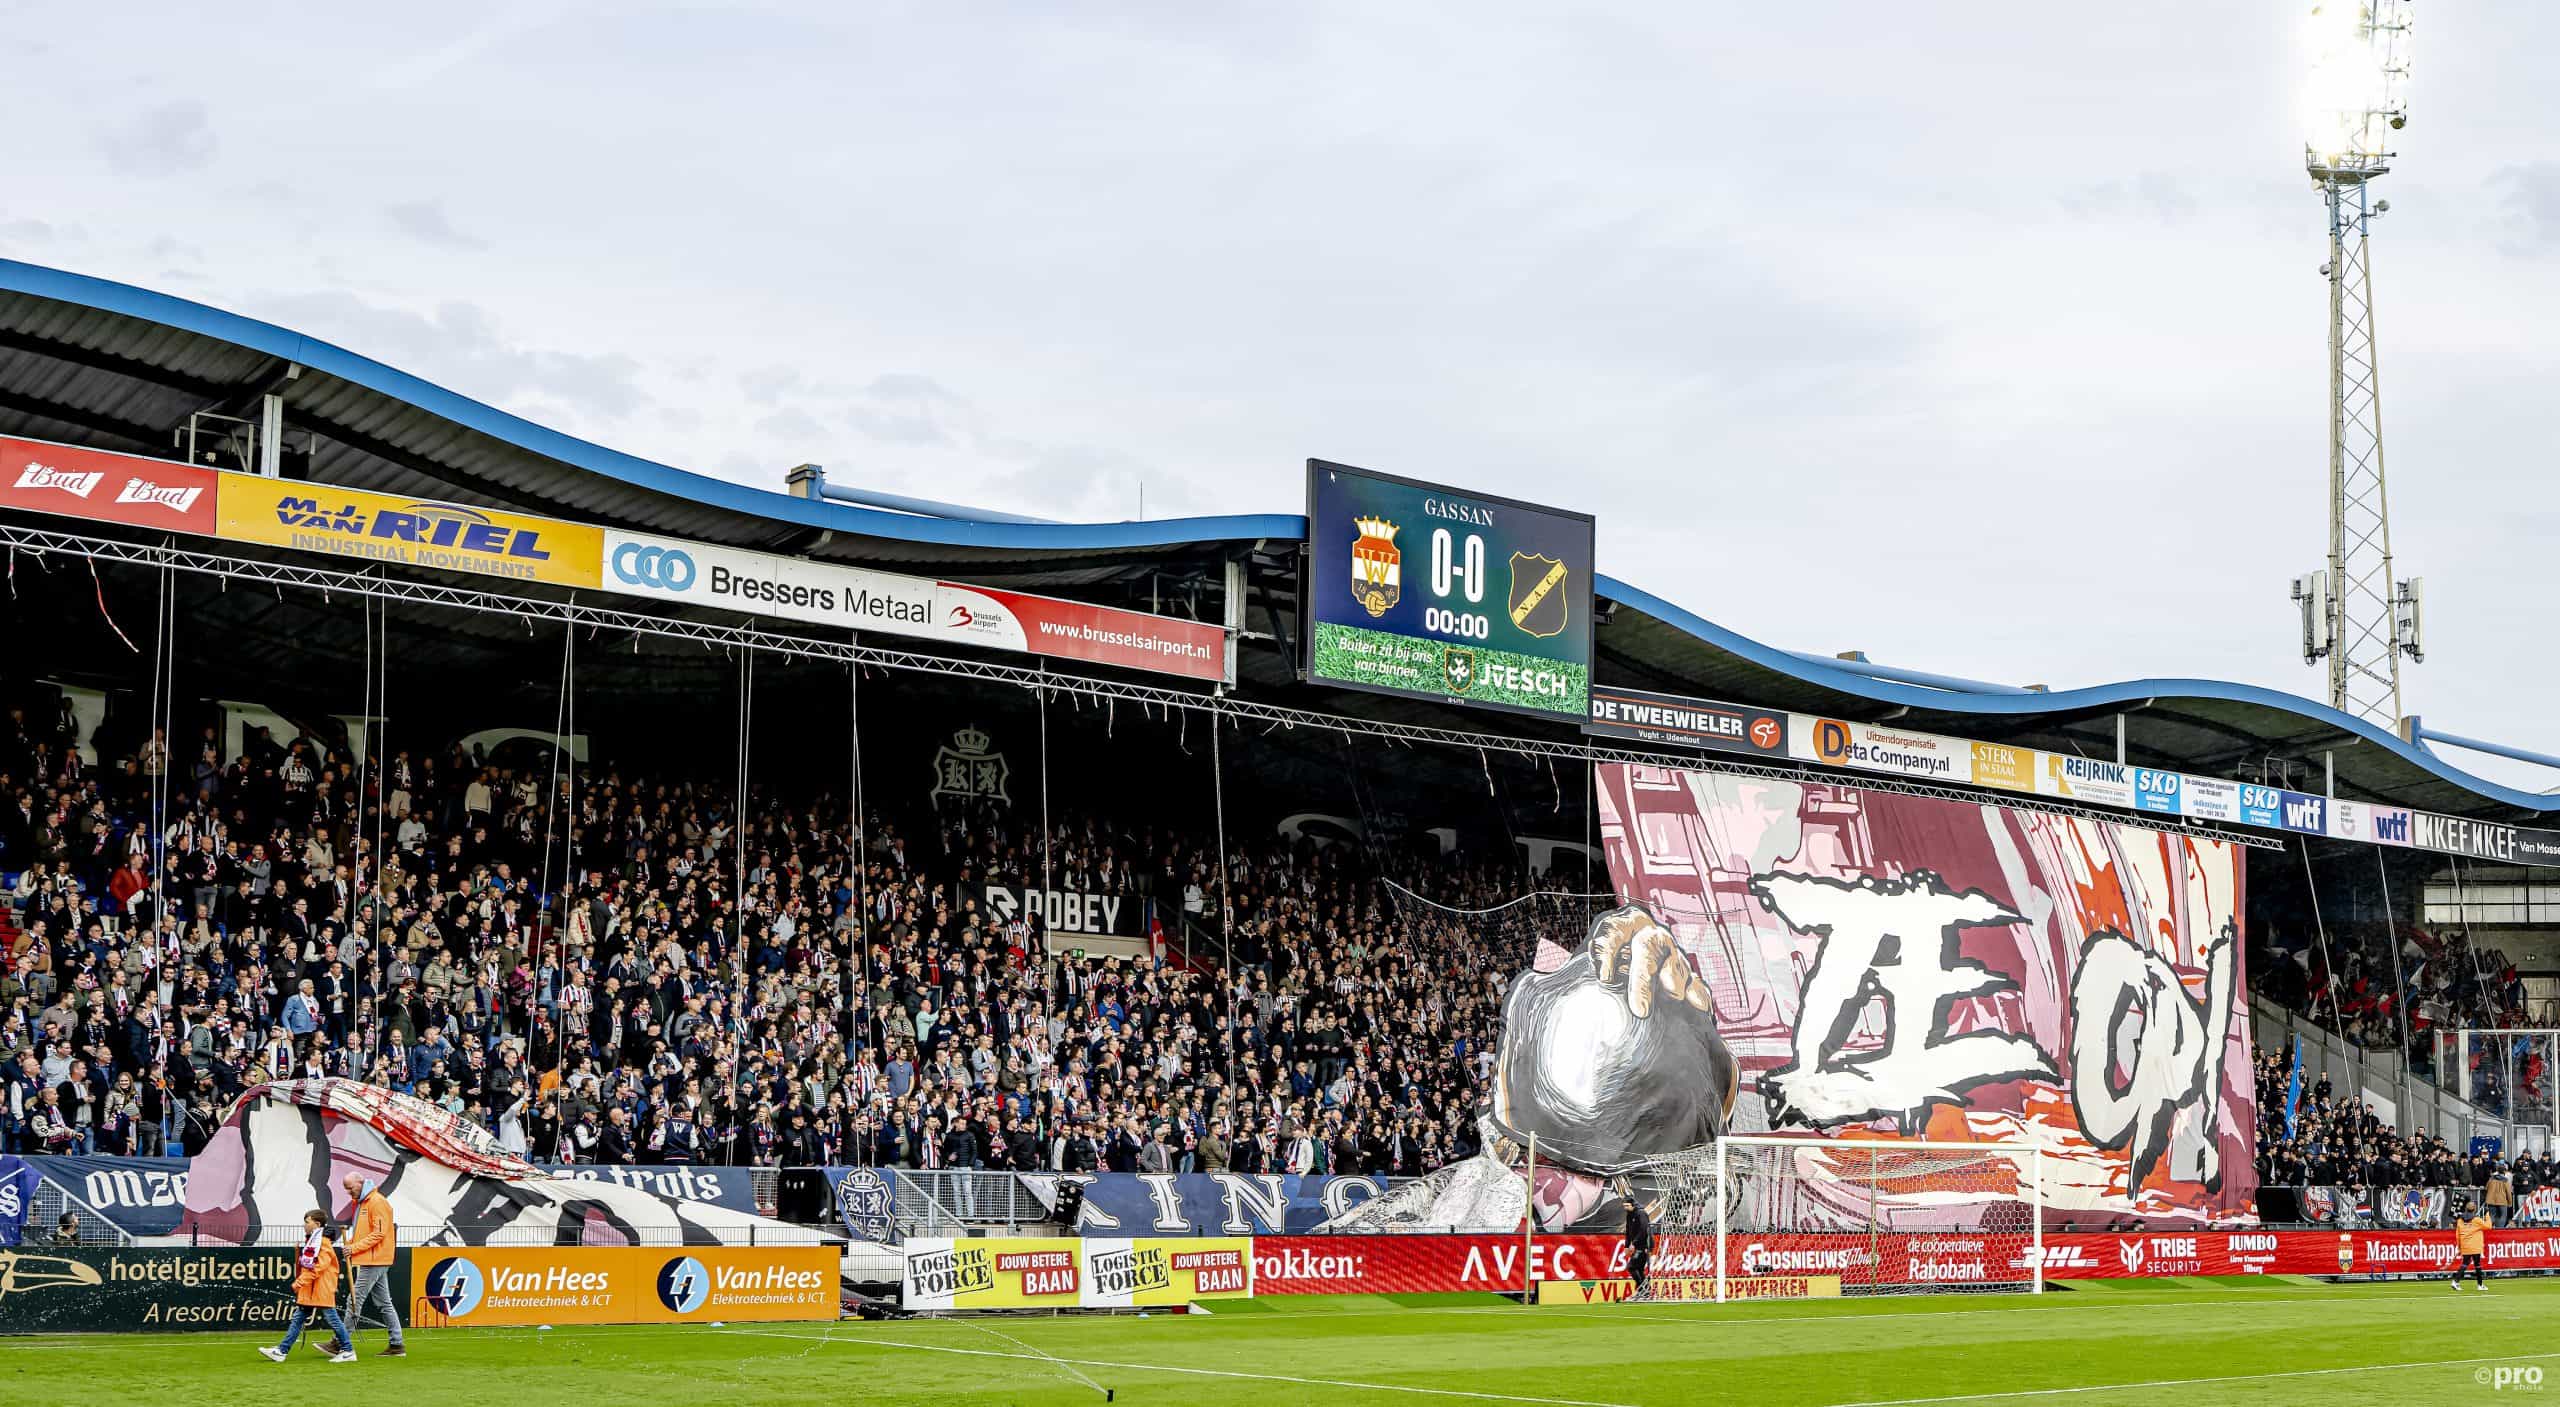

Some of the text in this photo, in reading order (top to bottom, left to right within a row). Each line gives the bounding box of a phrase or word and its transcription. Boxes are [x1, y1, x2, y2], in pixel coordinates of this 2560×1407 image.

[277, 496, 367, 519] M.J.
[1424, 498, 1495, 527] GASSAN
[277, 509, 550, 560] VAN RIEL
[291, 533, 536, 579] INDUSTRIAL MOVEMENTS
[1431, 528, 1485, 603] 0-0
[711, 566, 932, 625] Bressers Metaal
[973, 610, 1002, 622] brussels
[973, 619, 997, 629] airport
[1425, 607, 1489, 640] 00:00
[1039, 619, 1211, 659] www.brusselsairport.nl
[1339, 637, 1377, 655] Buiten
[1379, 645, 1394, 657] zit
[1412, 651, 1433, 663] ons
[1355, 659, 1377, 672] van
[1592, 699, 1744, 736] DE TWEEWIELER
[1823, 723, 1951, 773] Deta Company.nl
[1866, 730, 1937, 751] Uitzendorganisatie
[1979, 745, 2016, 766] STERK
[1980, 761, 2016, 777] IN STAAL
[2066, 758, 2126, 784] REIJRINK
[2139, 770, 2178, 796] SKD
[2243, 786, 2279, 810] SKD
[2286, 798, 2320, 830] wtf
[2376, 812, 2407, 841] wtf
[2519, 841, 2535, 853] Van
[85, 1170, 189, 1210] onze
[1608, 1239, 1713, 1273] Bnheur
[2151, 1238, 2197, 1258] TRIBE
[2228, 1235, 2278, 1251] JUMBO
[2488, 1239, 2546, 1265] partners
[911, 1248, 987, 1275] LOGISTIC
[999, 1253, 1069, 1270] JOUW BETERE
[1093, 1248, 1163, 1275] LOGISTIC
[1174, 1252, 1238, 1268] JOUW BETERE
[1461, 1245, 1576, 1282] AVEC
[1908, 1258, 1986, 1280] Rabobank
[2022, 1246, 2087, 1268] DHL
[2147, 1261, 2202, 1273] SECURITY
[491, 1266, 609, 1292] Van Hees
[716, 1265, 823, 1289] Van Hees
[912, 1264, 991, 1297] FORCE
[1025, 1269, 1075, 1295] BAAN
[1094, 1262, 1168, 1294] FORCE
[1198, 1268, 1243, 1292] BAAN
[487, 1294, 613, 1308] Elektrotechniek & ICT
[712, 1292, 826, 1305] Elektrotechniek & ICT
[1600, 1280, 1684, 1302] VLAMAN
[143, 1299, 323, 1327] A resort feelig.
